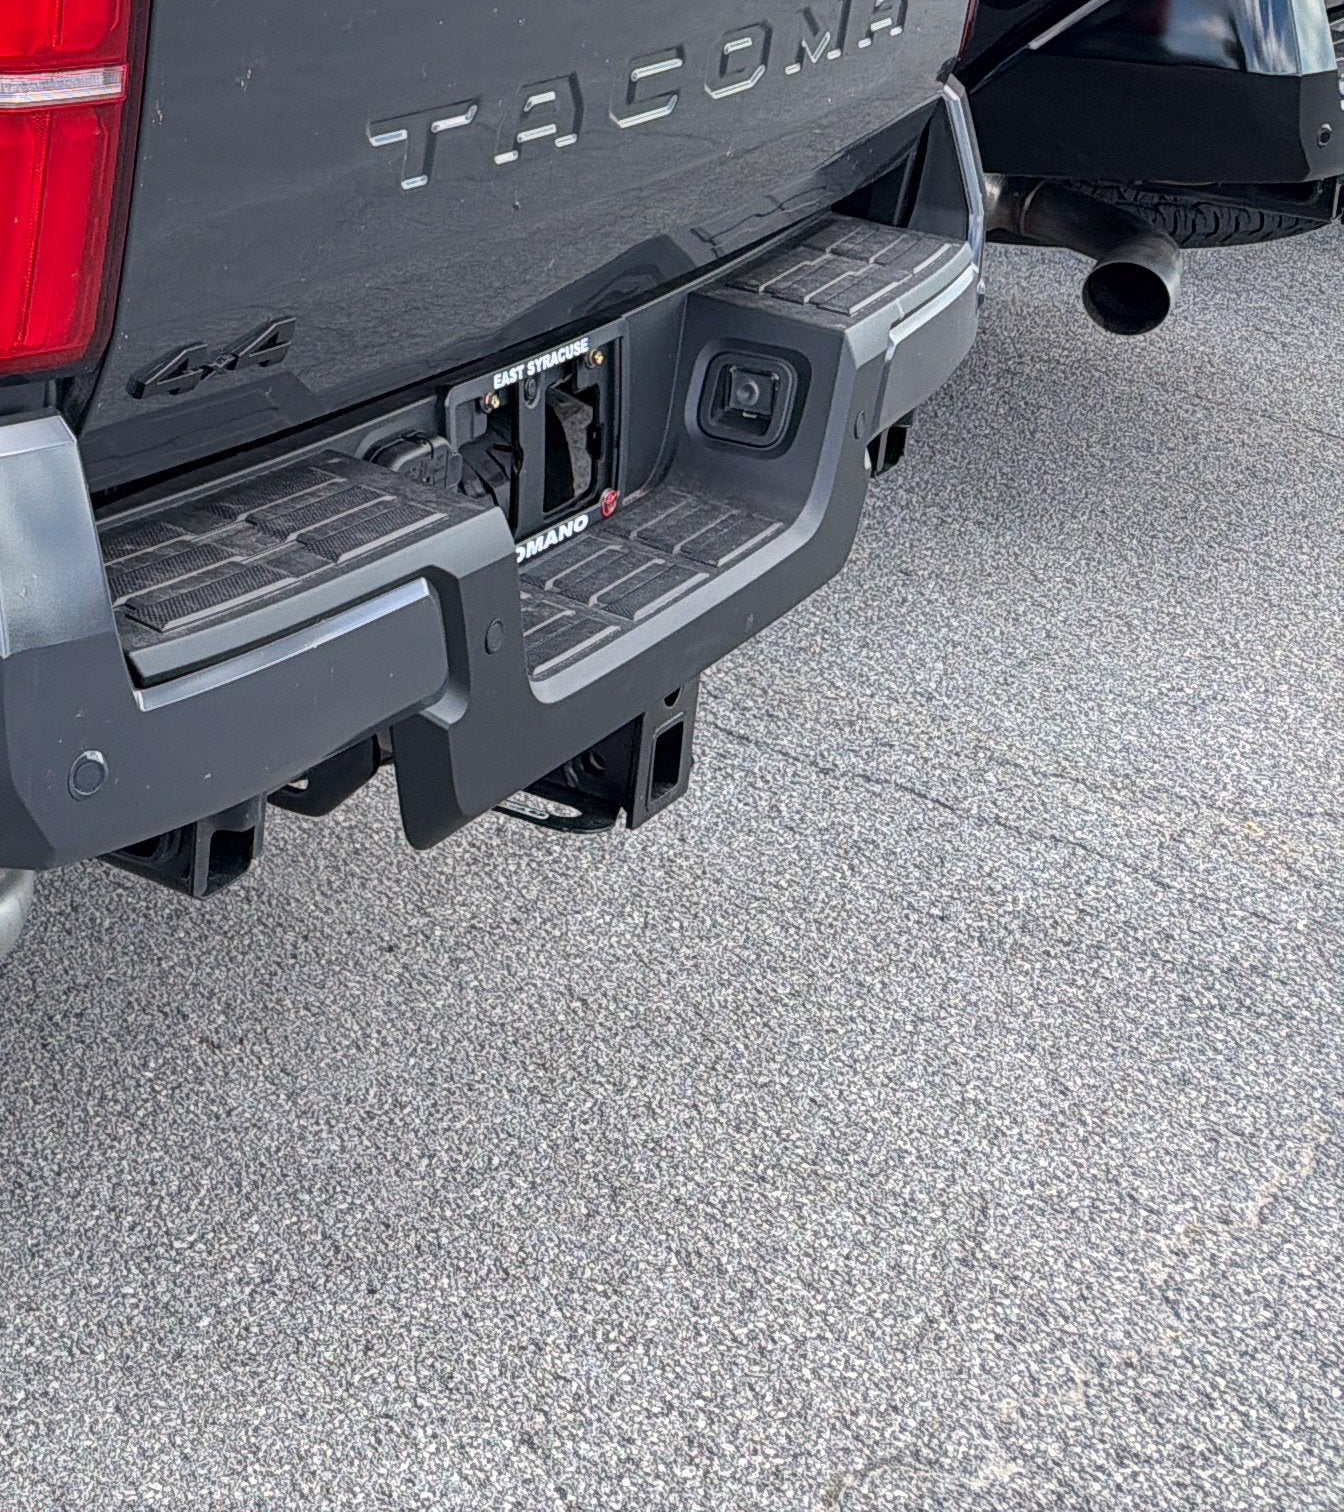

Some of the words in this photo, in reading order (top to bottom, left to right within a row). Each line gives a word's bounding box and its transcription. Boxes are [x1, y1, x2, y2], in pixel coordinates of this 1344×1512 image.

[493, 364, 525, 390] EAST
[527, 337, 589, 376] SYRACUSE
[515, 514, 589, 564] OMANO
